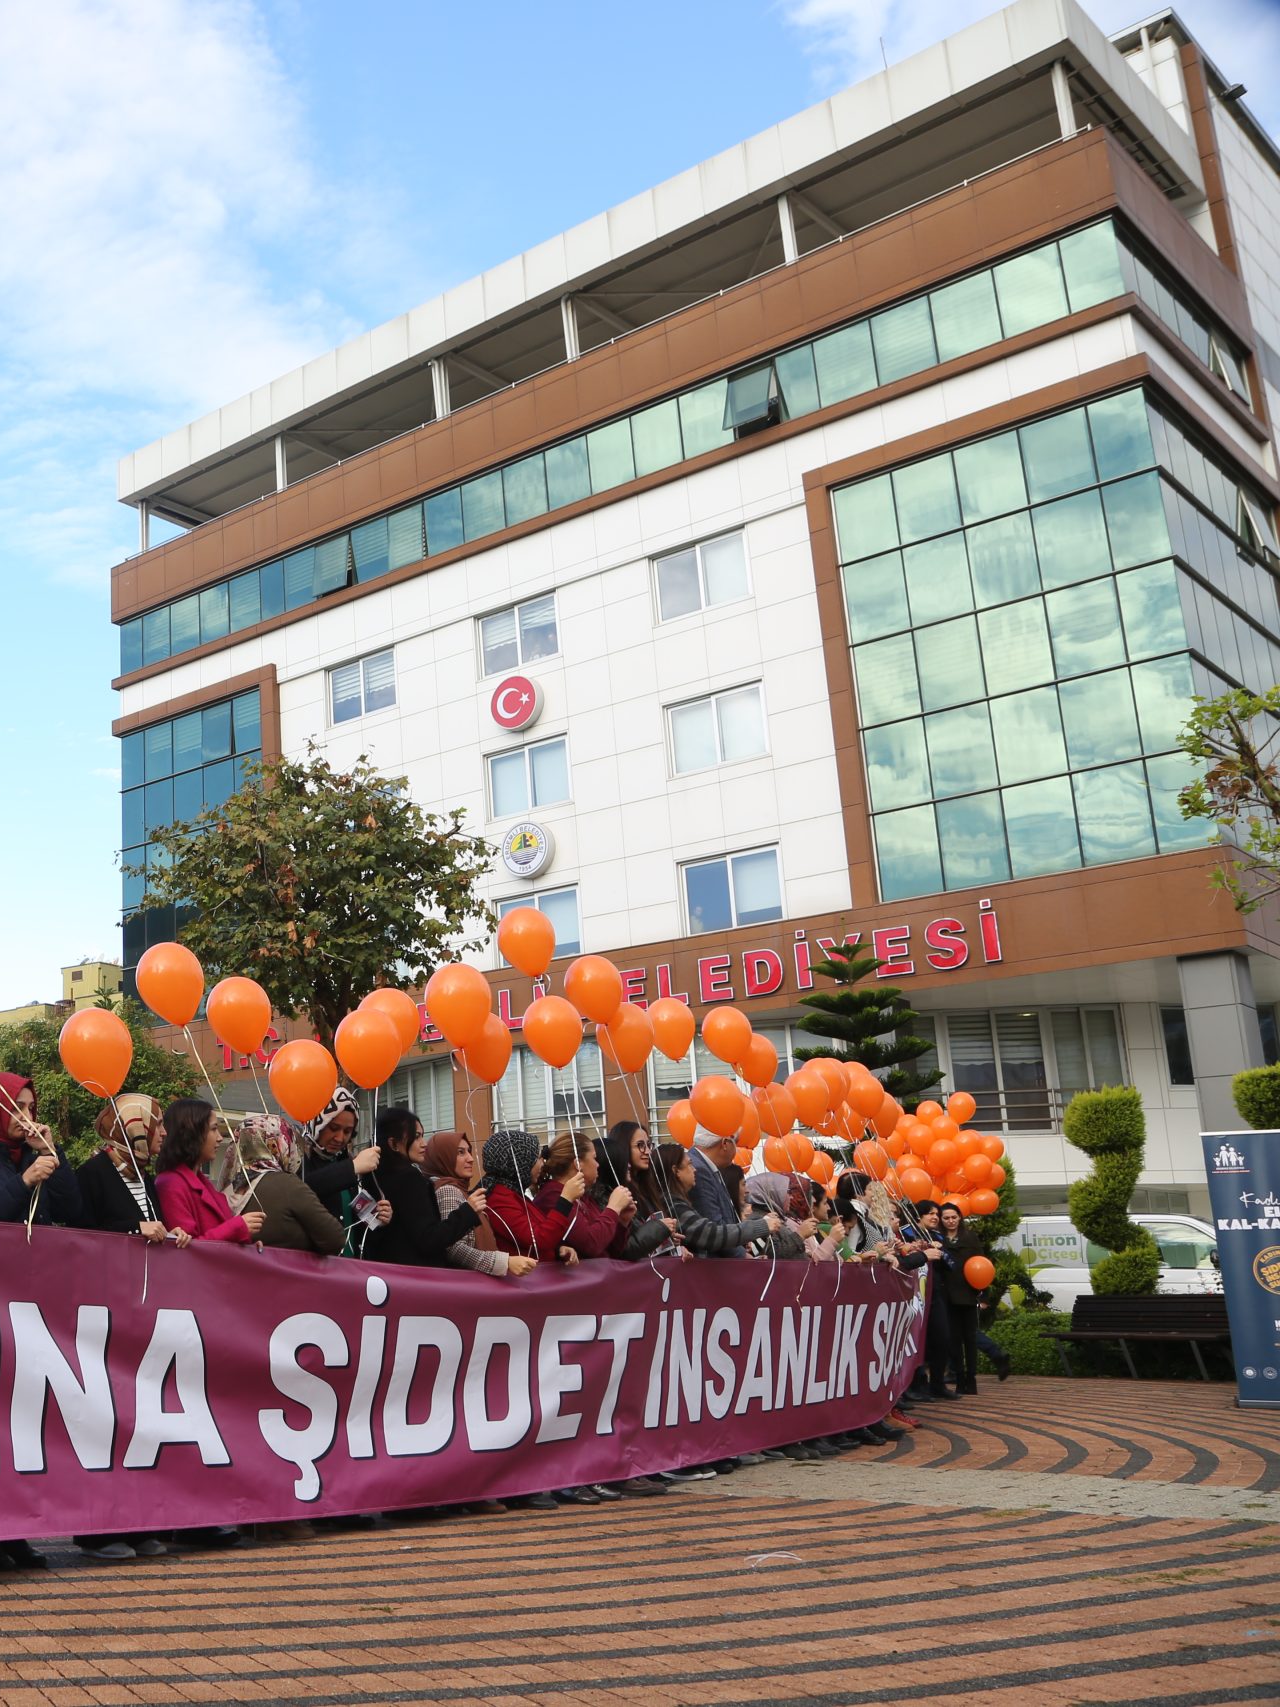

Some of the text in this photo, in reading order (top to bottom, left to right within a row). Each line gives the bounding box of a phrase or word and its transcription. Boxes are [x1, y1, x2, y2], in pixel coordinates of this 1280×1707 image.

[580, 898, 1003, 1019] ELEDİYESİ
[1021, 1234, 1077, 1247] Limon
[257, 1275, 646, 1502] ŞİDDET
[643, 1276, 868, 1429] İNSANLIK
